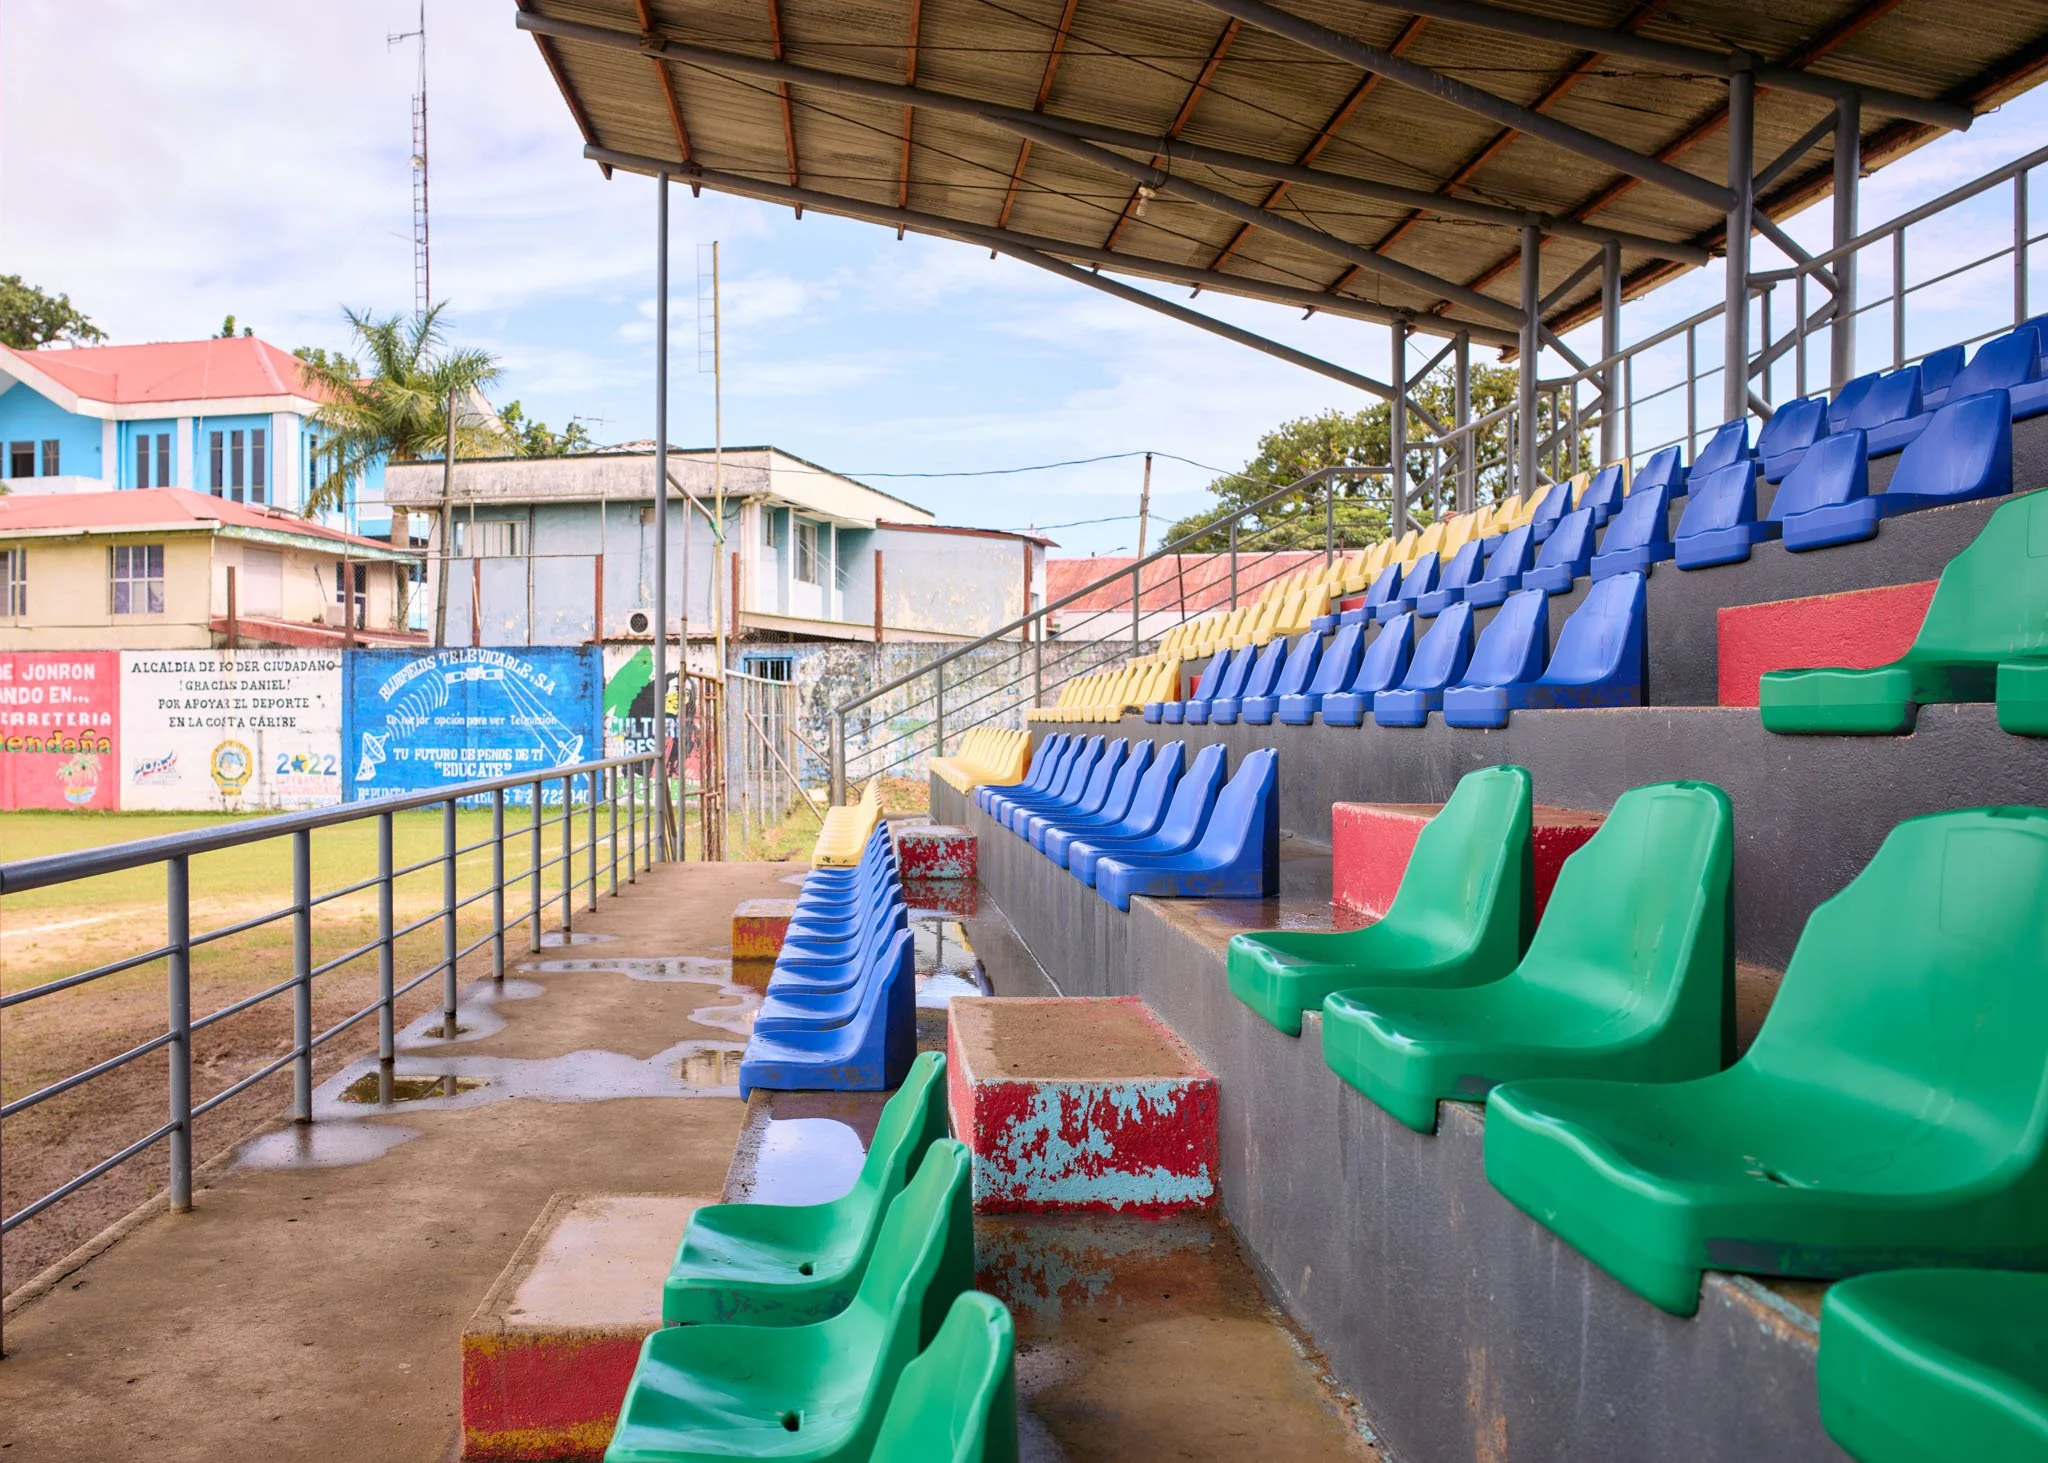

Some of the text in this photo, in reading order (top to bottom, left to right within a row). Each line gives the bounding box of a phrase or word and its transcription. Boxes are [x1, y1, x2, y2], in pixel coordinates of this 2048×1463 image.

[22, 663, 96, 681] JONRON
[131, 661, 196, 673] ALCALDIA
[199, 661, 215, 672] DE
[263, 660, 336, 672] CIUDADANO
[158, 699, 181, 709] POR
[232, 699, 248, 709] EL
[252, 698, 310, 709] DEPORTE
[169, 716, 185, 728] EN
[188, 717, 203, 727] LA
[434, 711, 465, 728] opción
[466, 715, 488, 728] para
[489, 716, 506, 725] ver
[393, 748, 409, 760] TU
[414, 748, 458, 760] FUTURO
[515, 749, 529, 761] DE
[531, 748, 544, 761] TI
